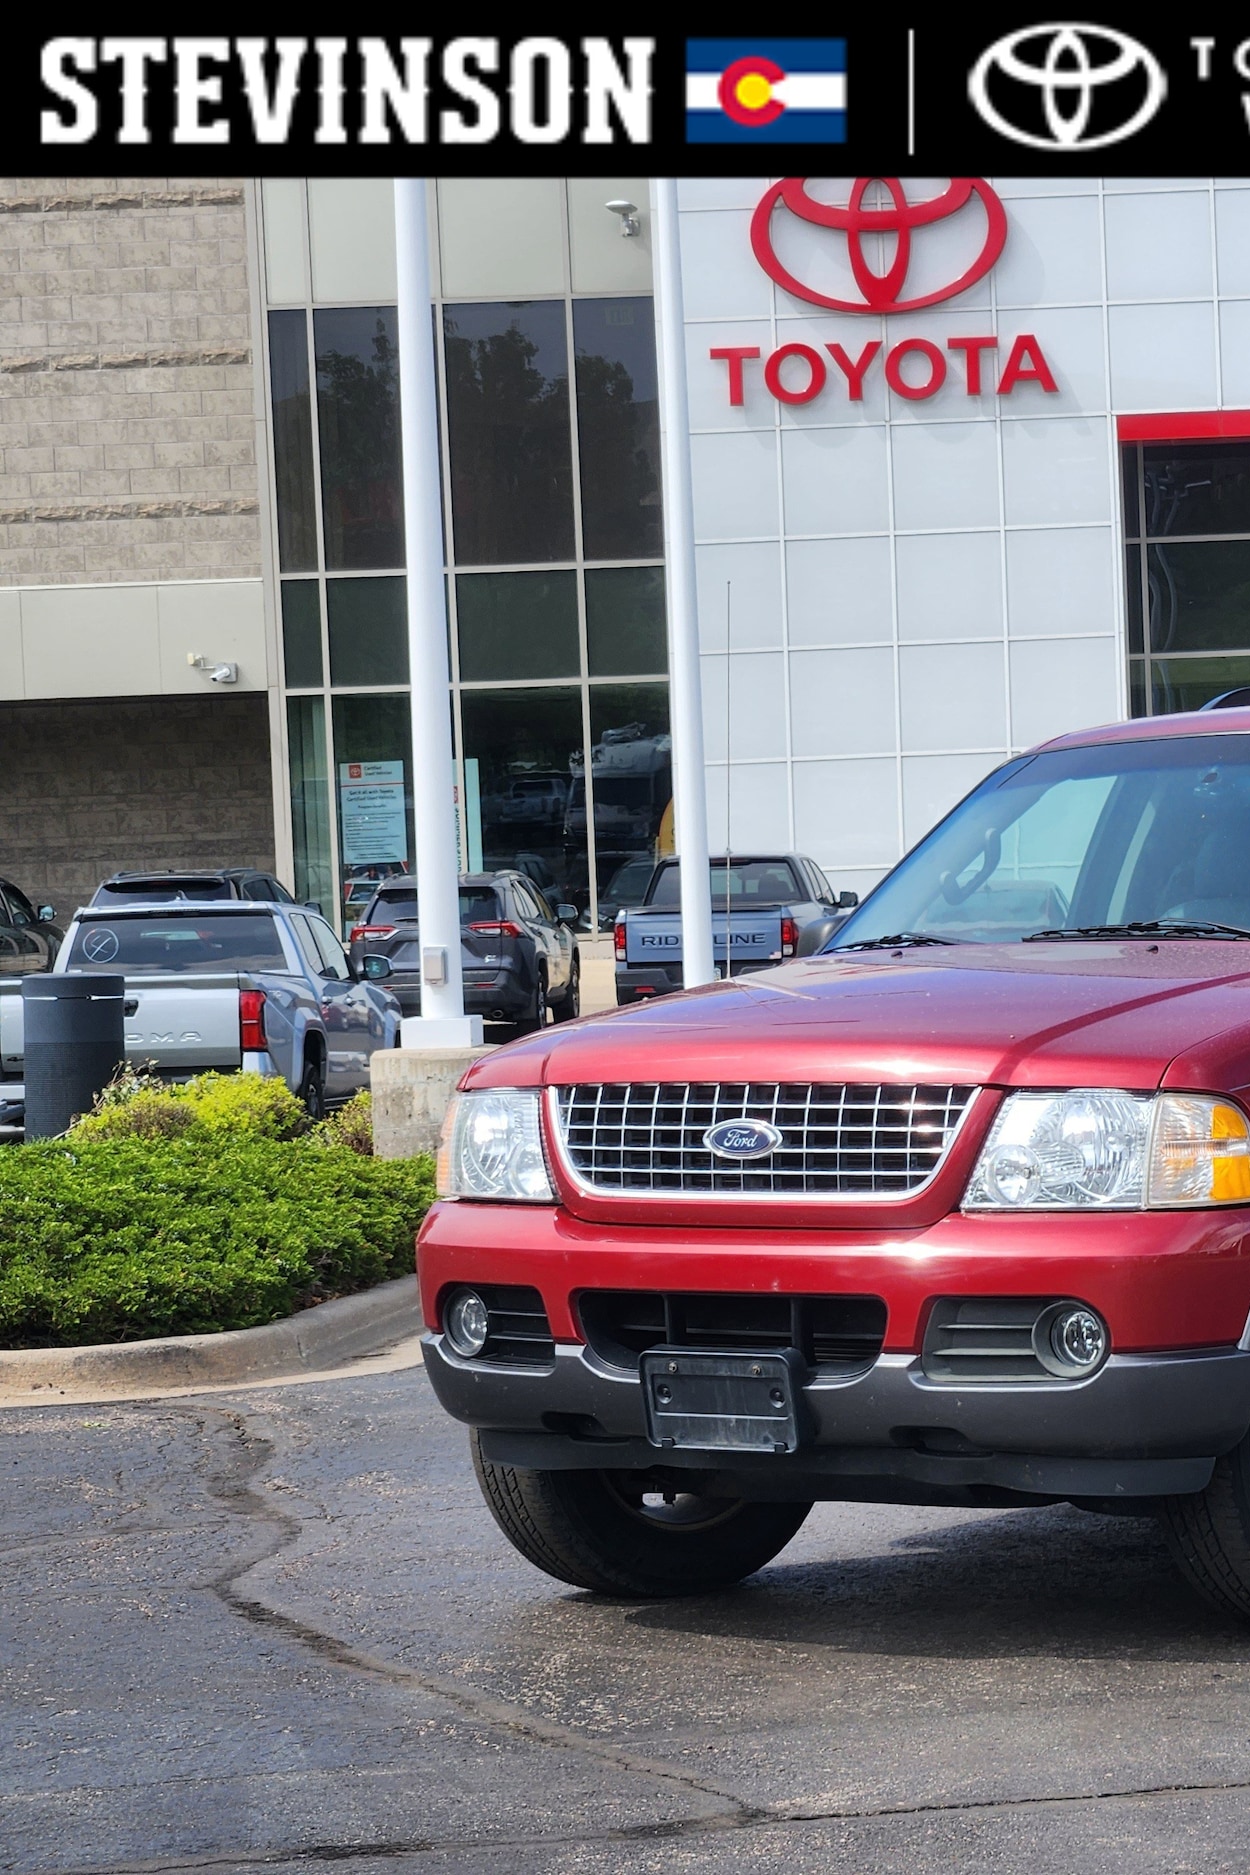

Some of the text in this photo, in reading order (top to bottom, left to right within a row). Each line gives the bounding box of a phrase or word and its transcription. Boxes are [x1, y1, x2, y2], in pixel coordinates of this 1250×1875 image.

[710, 335, 1058, 406] TOYOTA
[641, 933, 767, 946] RIDLINE
[723, 1129, 758, 1147] Ford
